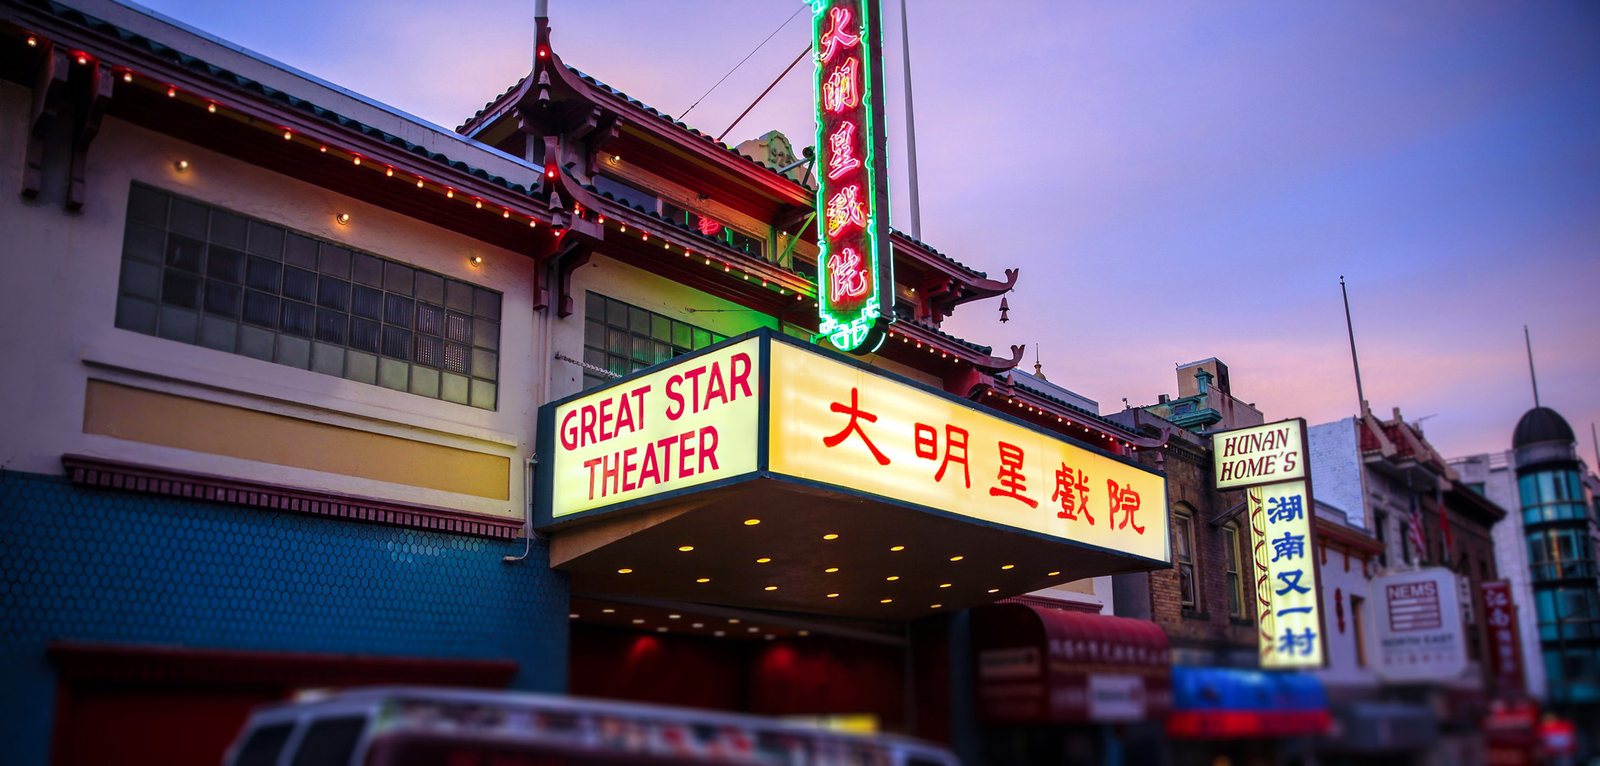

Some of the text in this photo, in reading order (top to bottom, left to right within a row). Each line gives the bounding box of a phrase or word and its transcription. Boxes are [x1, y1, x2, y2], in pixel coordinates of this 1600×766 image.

[560, 351, 754, 451] GREAT STAR
[583, 425, 720, 501] THEATER
[822, 386, 1146, 536] 大明星戲院
[1219, 451, 1297, 482] HOME'S
[1222, 428, 1290, 458] HUNAN
[1267, 494, 1316, 656] 湖南又一村
[1388, 583, 1436, 598] NEMS
